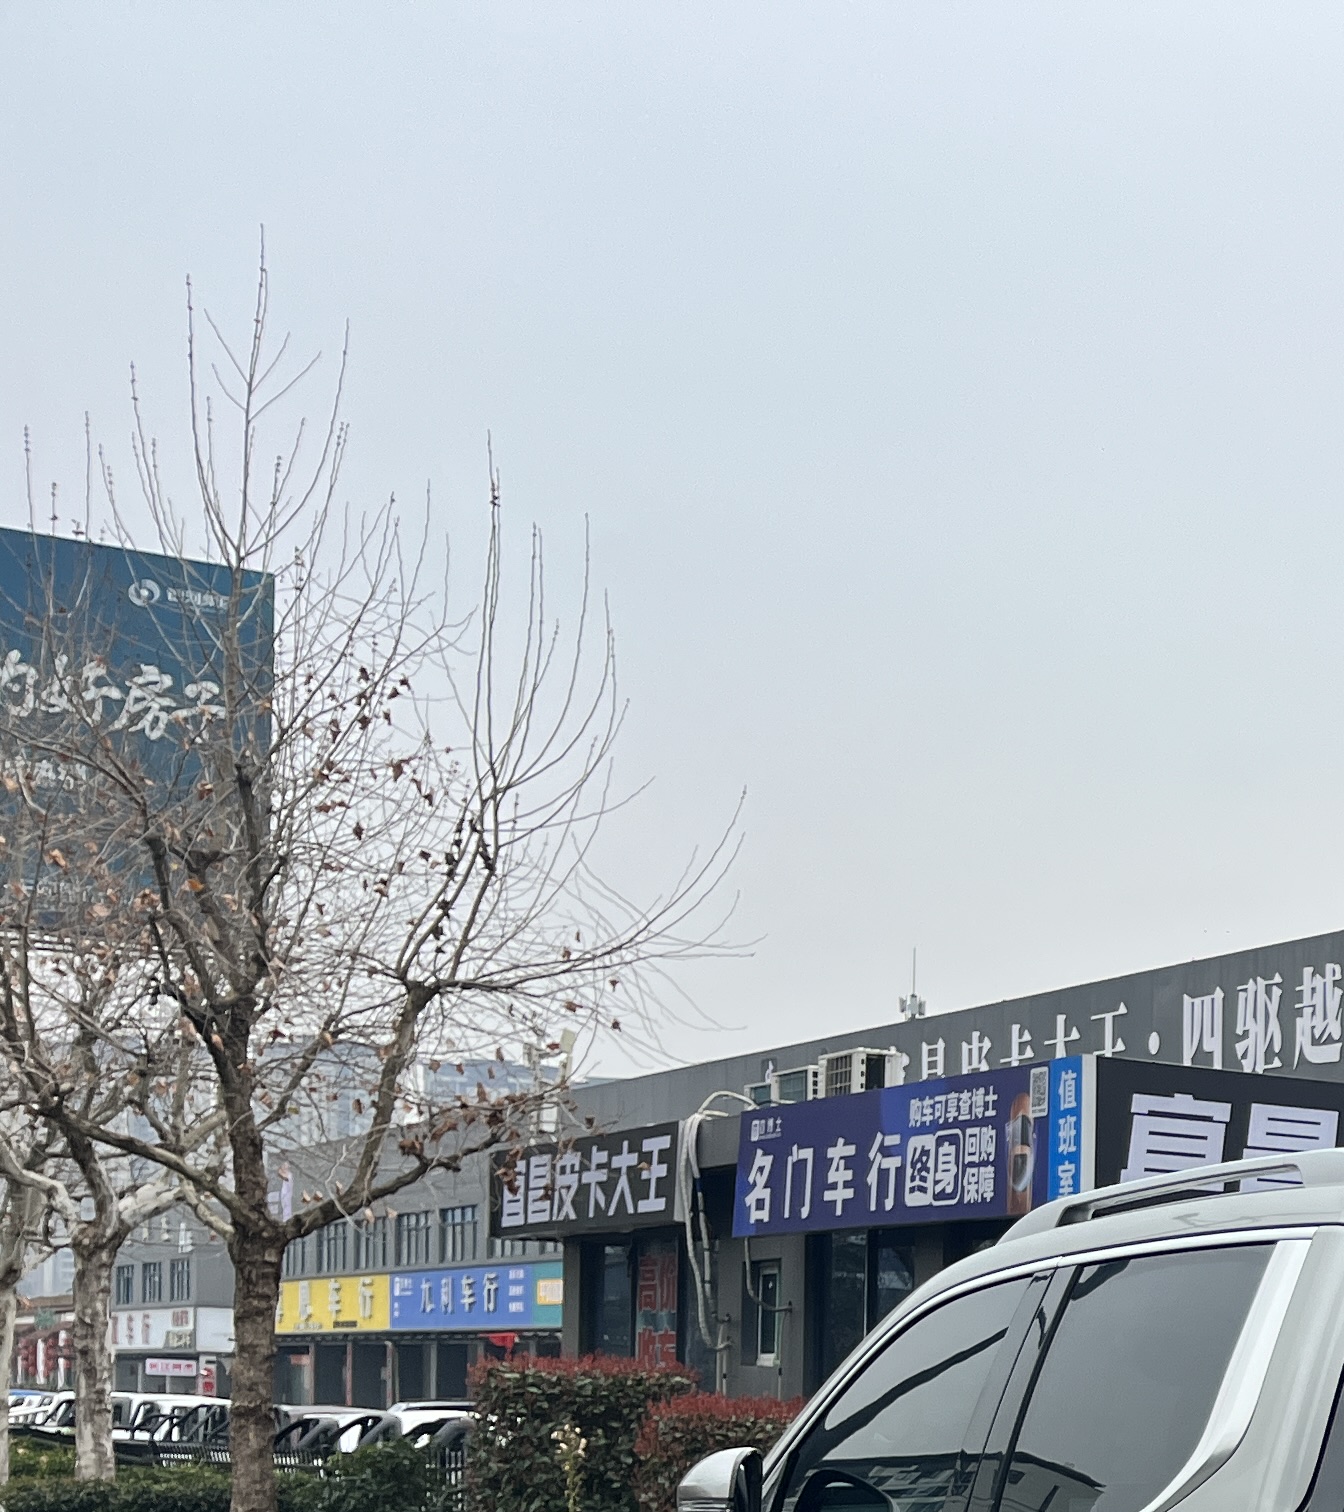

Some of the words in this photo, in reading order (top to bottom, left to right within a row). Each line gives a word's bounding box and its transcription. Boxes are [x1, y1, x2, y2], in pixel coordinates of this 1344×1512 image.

[908, 1085, 998, 1128] 购车可享查博士
[964, 1124, 997, 1165] 回购
[1057, 1069, 1079, 1199] 值班室
[744, 1131, 902, 1225] 名门车行
[907, 1138, 960, 1199] 终身
[962, 1164, 995, 1205] 保障
